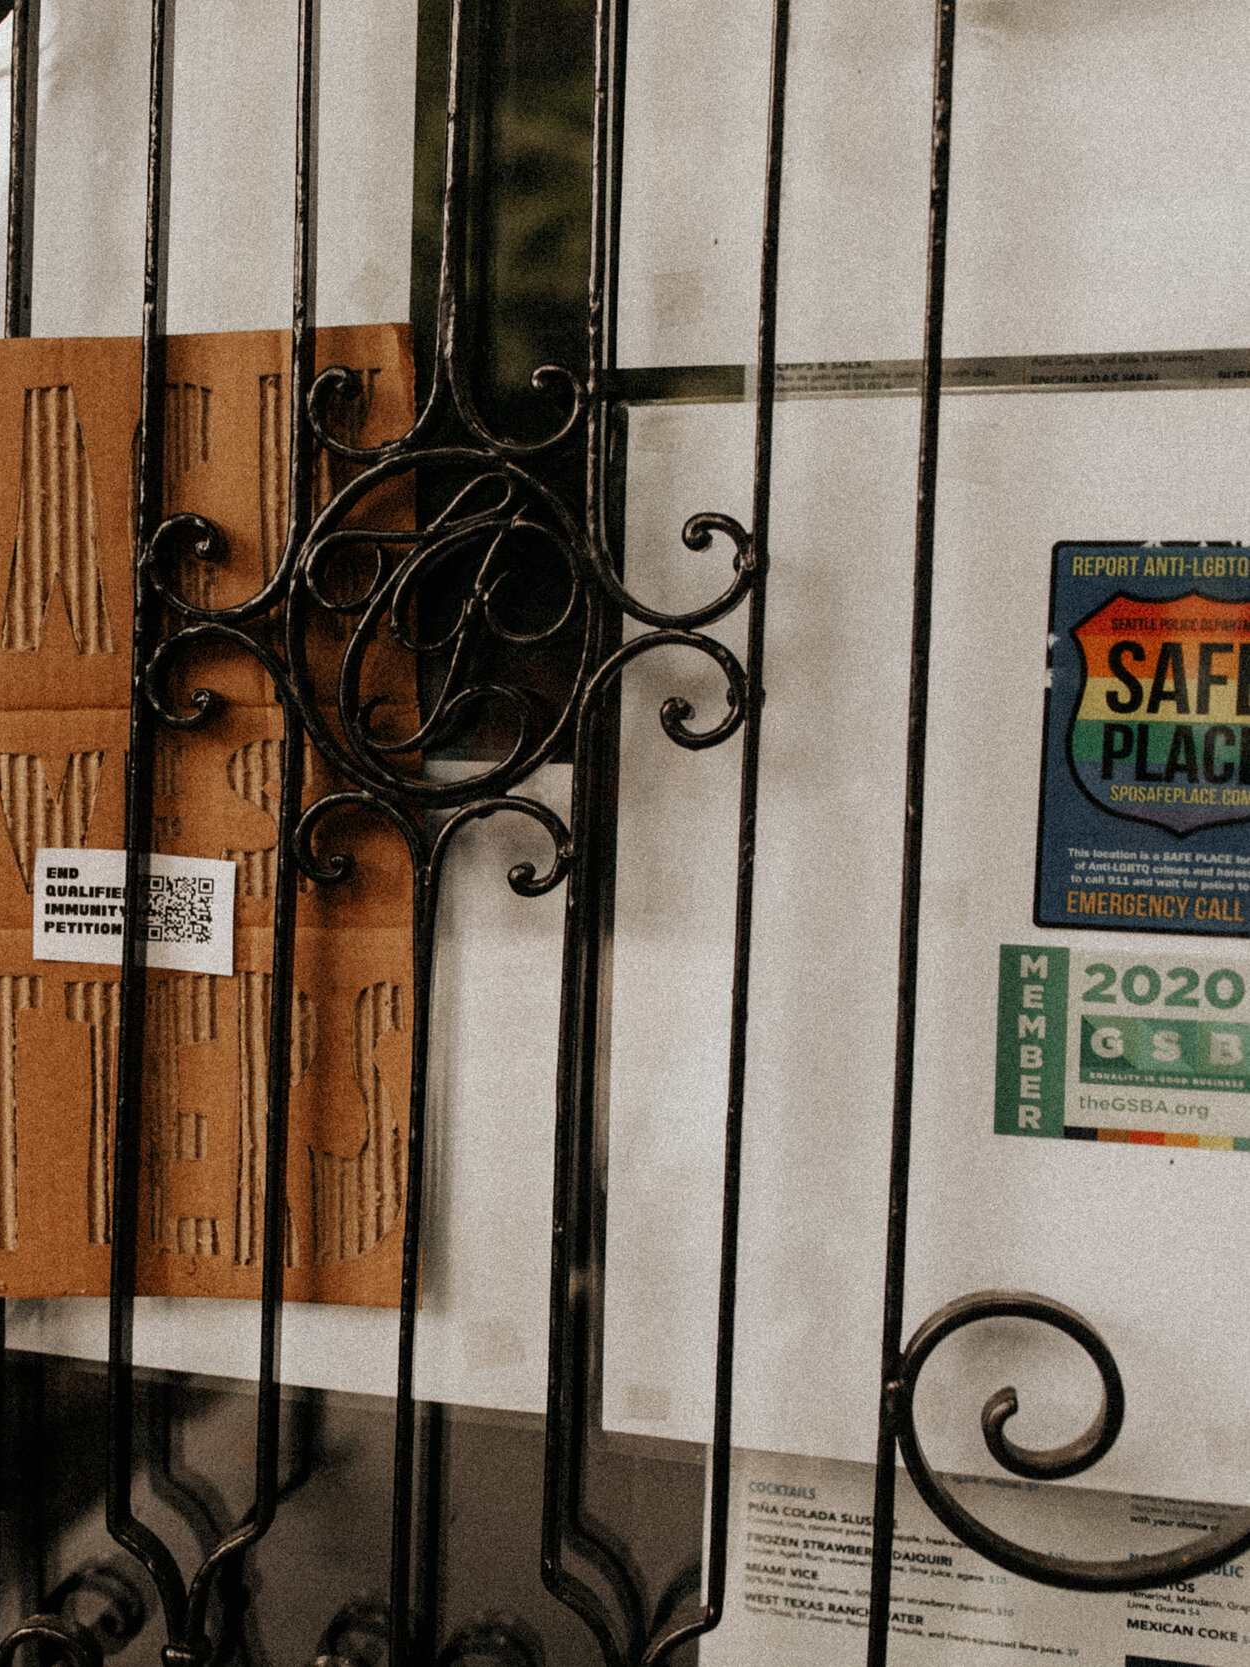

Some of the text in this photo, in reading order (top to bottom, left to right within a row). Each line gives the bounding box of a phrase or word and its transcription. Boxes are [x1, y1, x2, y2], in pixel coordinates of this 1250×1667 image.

[1072, 556, 1250, 578] REPORT ANTI-LGBTQ
[1111, 617, 1157, 631] SEATTLE
[1160, 617, 1198, 632] POLICE
[1067, 848, 1090, 858] This
[1093, 849, 1137, 860] location
[1140, 850, 1150, 861] is
[1153, 853, 1160, 861] a
[1163, 851, 1193, 863] SAFE
[1195, 853, 1233, 864] PLACE
[46, 867, 79, 880] END
[1074, 861, 1087, 871] of
[1088, 862, 1150, 875] Anti-LGBTQ
[1152, 864, 1190, 876] crimes
[1193, 866, 1214, 877] and
[1070, 874, 1082, 883] to
[1085, 874, 1105, 885] call
[1107, 875, 1130, 886] 911
[1132, 877, 1153, 887] and
[1156, 878, 1180, 889] wait
[1182, 879, 1198, 890] for
[1200, 879, 1235, 891] police
[45, 885, 126, 899] QUALIFIE
[1067, 890, 1245, 922] EMERGENCY CALL
[44, 921, 123, 935] PETITION
[1081, 963, 1246, 1010] 2020
[1017, 954, 1049, 1130] MEMBER
[1088, 1072, 1245, 1089] EQUALITY IS GOOD BUSINESS
[1079, 1095, 1210, 1120] theGSBA.org
[749, 1481, 816, 1500] COCKTAILS
[783, 1506, 837, 1522] COLADA
[1130, 1515, 1151, 1525] with
[1153, 1518, 1175, 1529] your
[1177, 1519, 1209, 1532] choice
[747, 1532, 953, 1567] FROZEN STRAWBER DAIQUIRI
[745, 1562, 819, 1580] MIAMI VICE
[744, 1592, 779, 1605] WEST
[783, 1597, 824, 1612] TEXAS
[891, 1612, 924, 1626] ATER
[1155, 1603, 1186, 1615] Guava
[1127, 1618, 1194, 1637] MEXICAN
[1198, 1627, 1238, 1643] COKE
